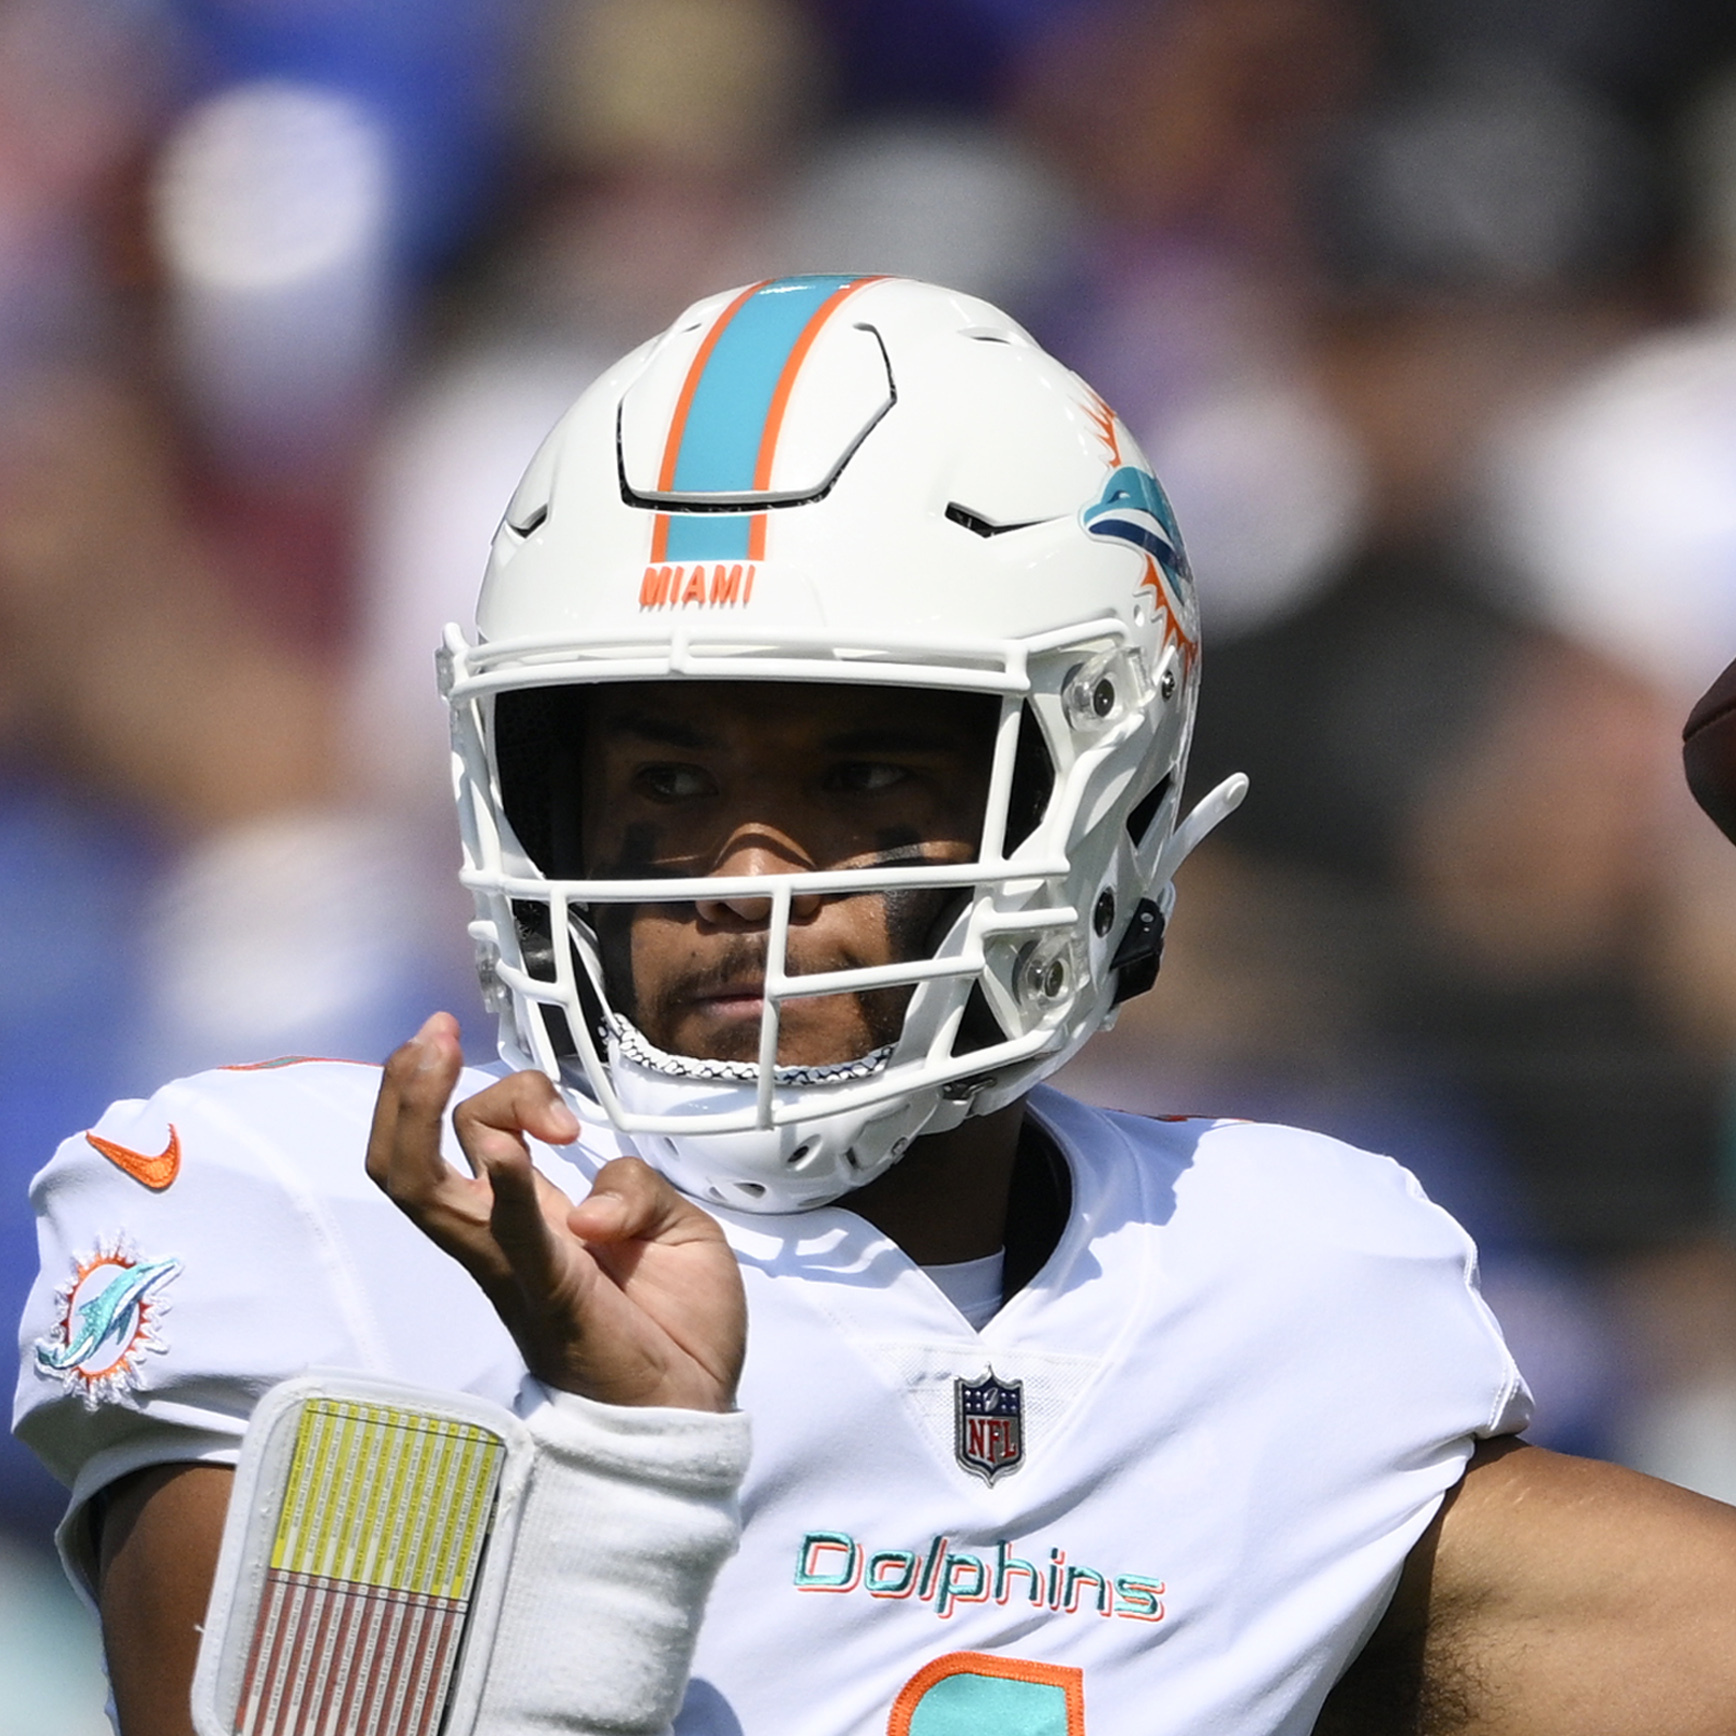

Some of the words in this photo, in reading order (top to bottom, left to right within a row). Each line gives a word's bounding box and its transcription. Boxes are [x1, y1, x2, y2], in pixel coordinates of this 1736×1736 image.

[638, 564, 756, 607] MIAMI
[968, 1418, 1017, 1463] NFL
[792, 1528, 1165, 1622] Dolphins
